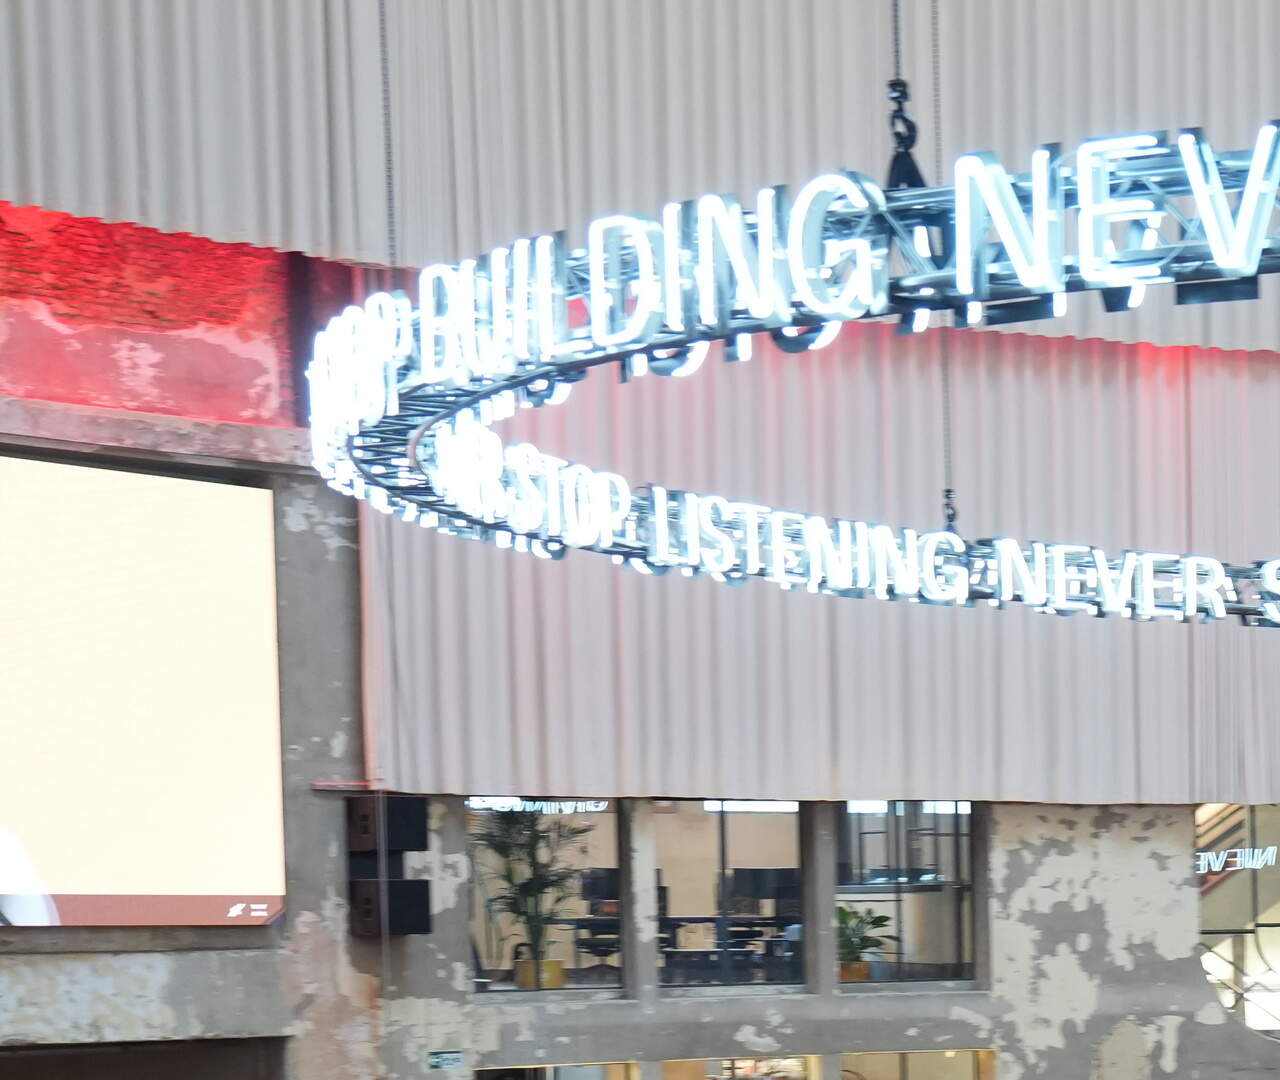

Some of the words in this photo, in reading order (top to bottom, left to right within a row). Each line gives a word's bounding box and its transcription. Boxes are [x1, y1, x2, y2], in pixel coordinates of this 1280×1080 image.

[418, 172, 882, 380] BUILDING
[503, 443, 632, 548] STOP
[655, 485, 968, 604] LISTENING
[997, 538, 1227, 618] NEVER
